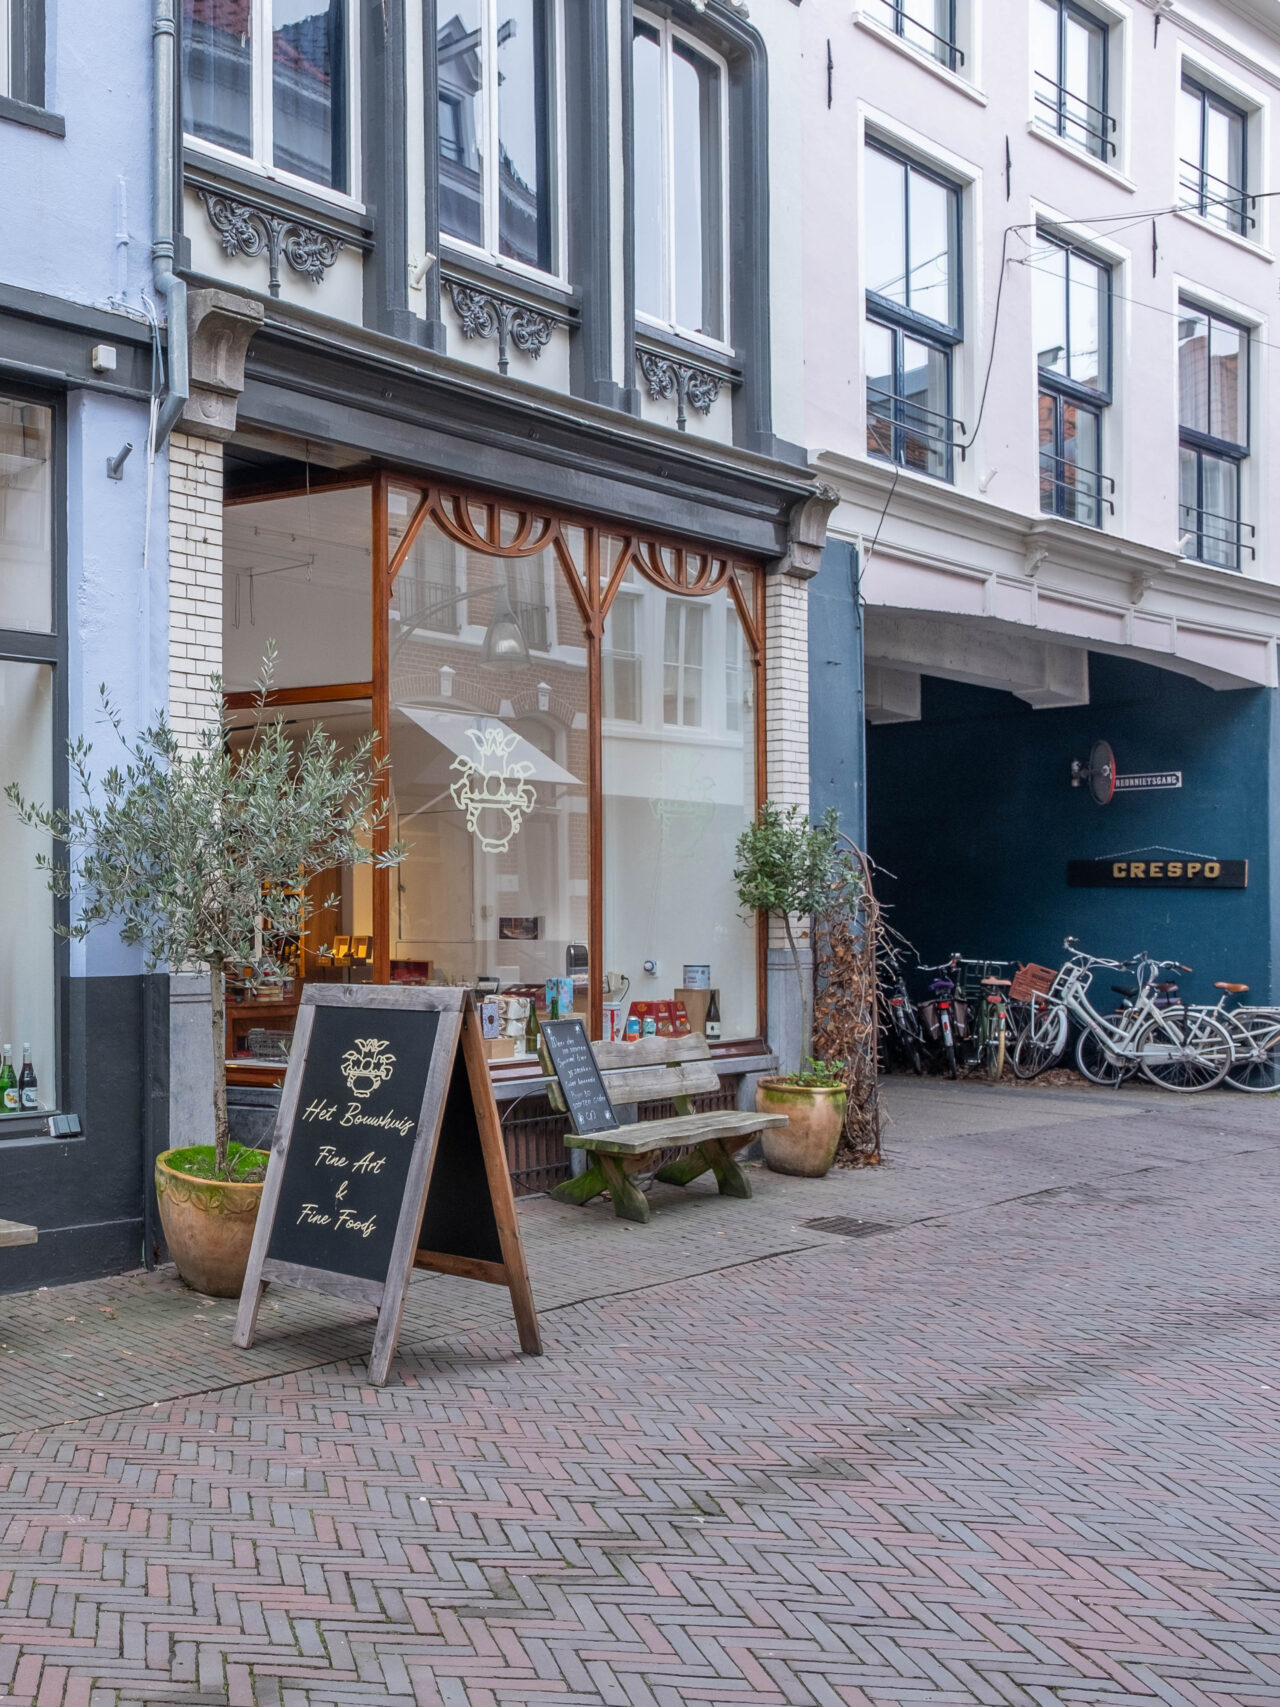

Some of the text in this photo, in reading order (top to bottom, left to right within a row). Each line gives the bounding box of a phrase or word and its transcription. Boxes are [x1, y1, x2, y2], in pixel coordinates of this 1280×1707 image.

[1113, 862, 1221, 878] CRESPO
[302, 1099, 415, 1136] Het Bouwhuis
[315, 1146, 386, 1174] Fine Art
[335, 1180, 348, 1200] &
[296, 1203, 376, 1238] Fine Foods
